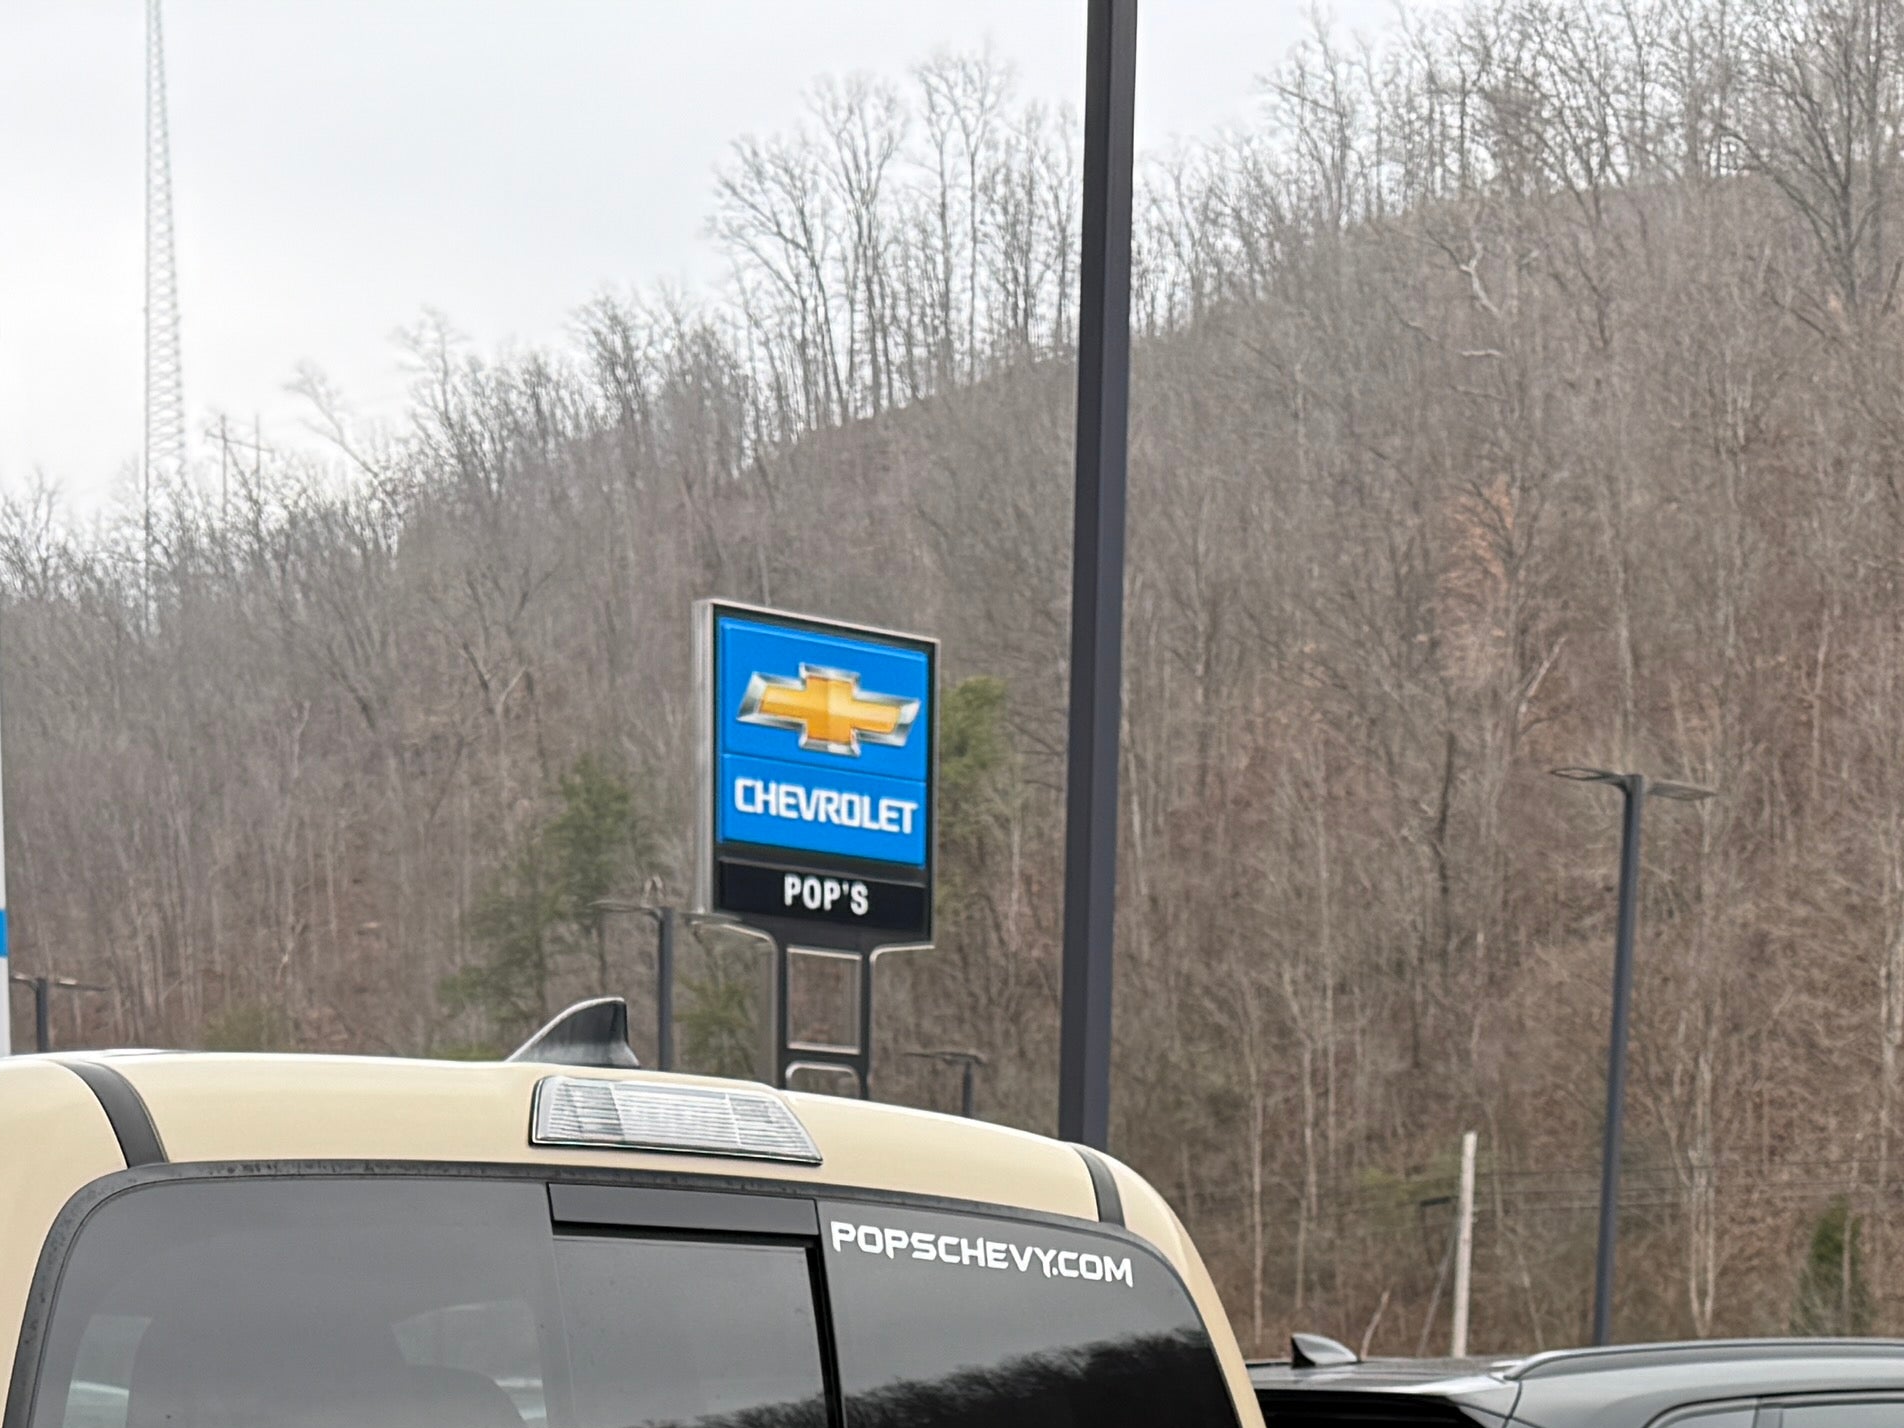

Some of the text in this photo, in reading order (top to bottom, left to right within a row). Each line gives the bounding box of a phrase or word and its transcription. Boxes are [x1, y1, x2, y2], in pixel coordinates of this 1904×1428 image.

[735, 777, 919, 834] CHEVROLET
[784, 872, 870, 916] POP'S
[830, 1220, 1134, 1288] POPSCHEVY.COM
